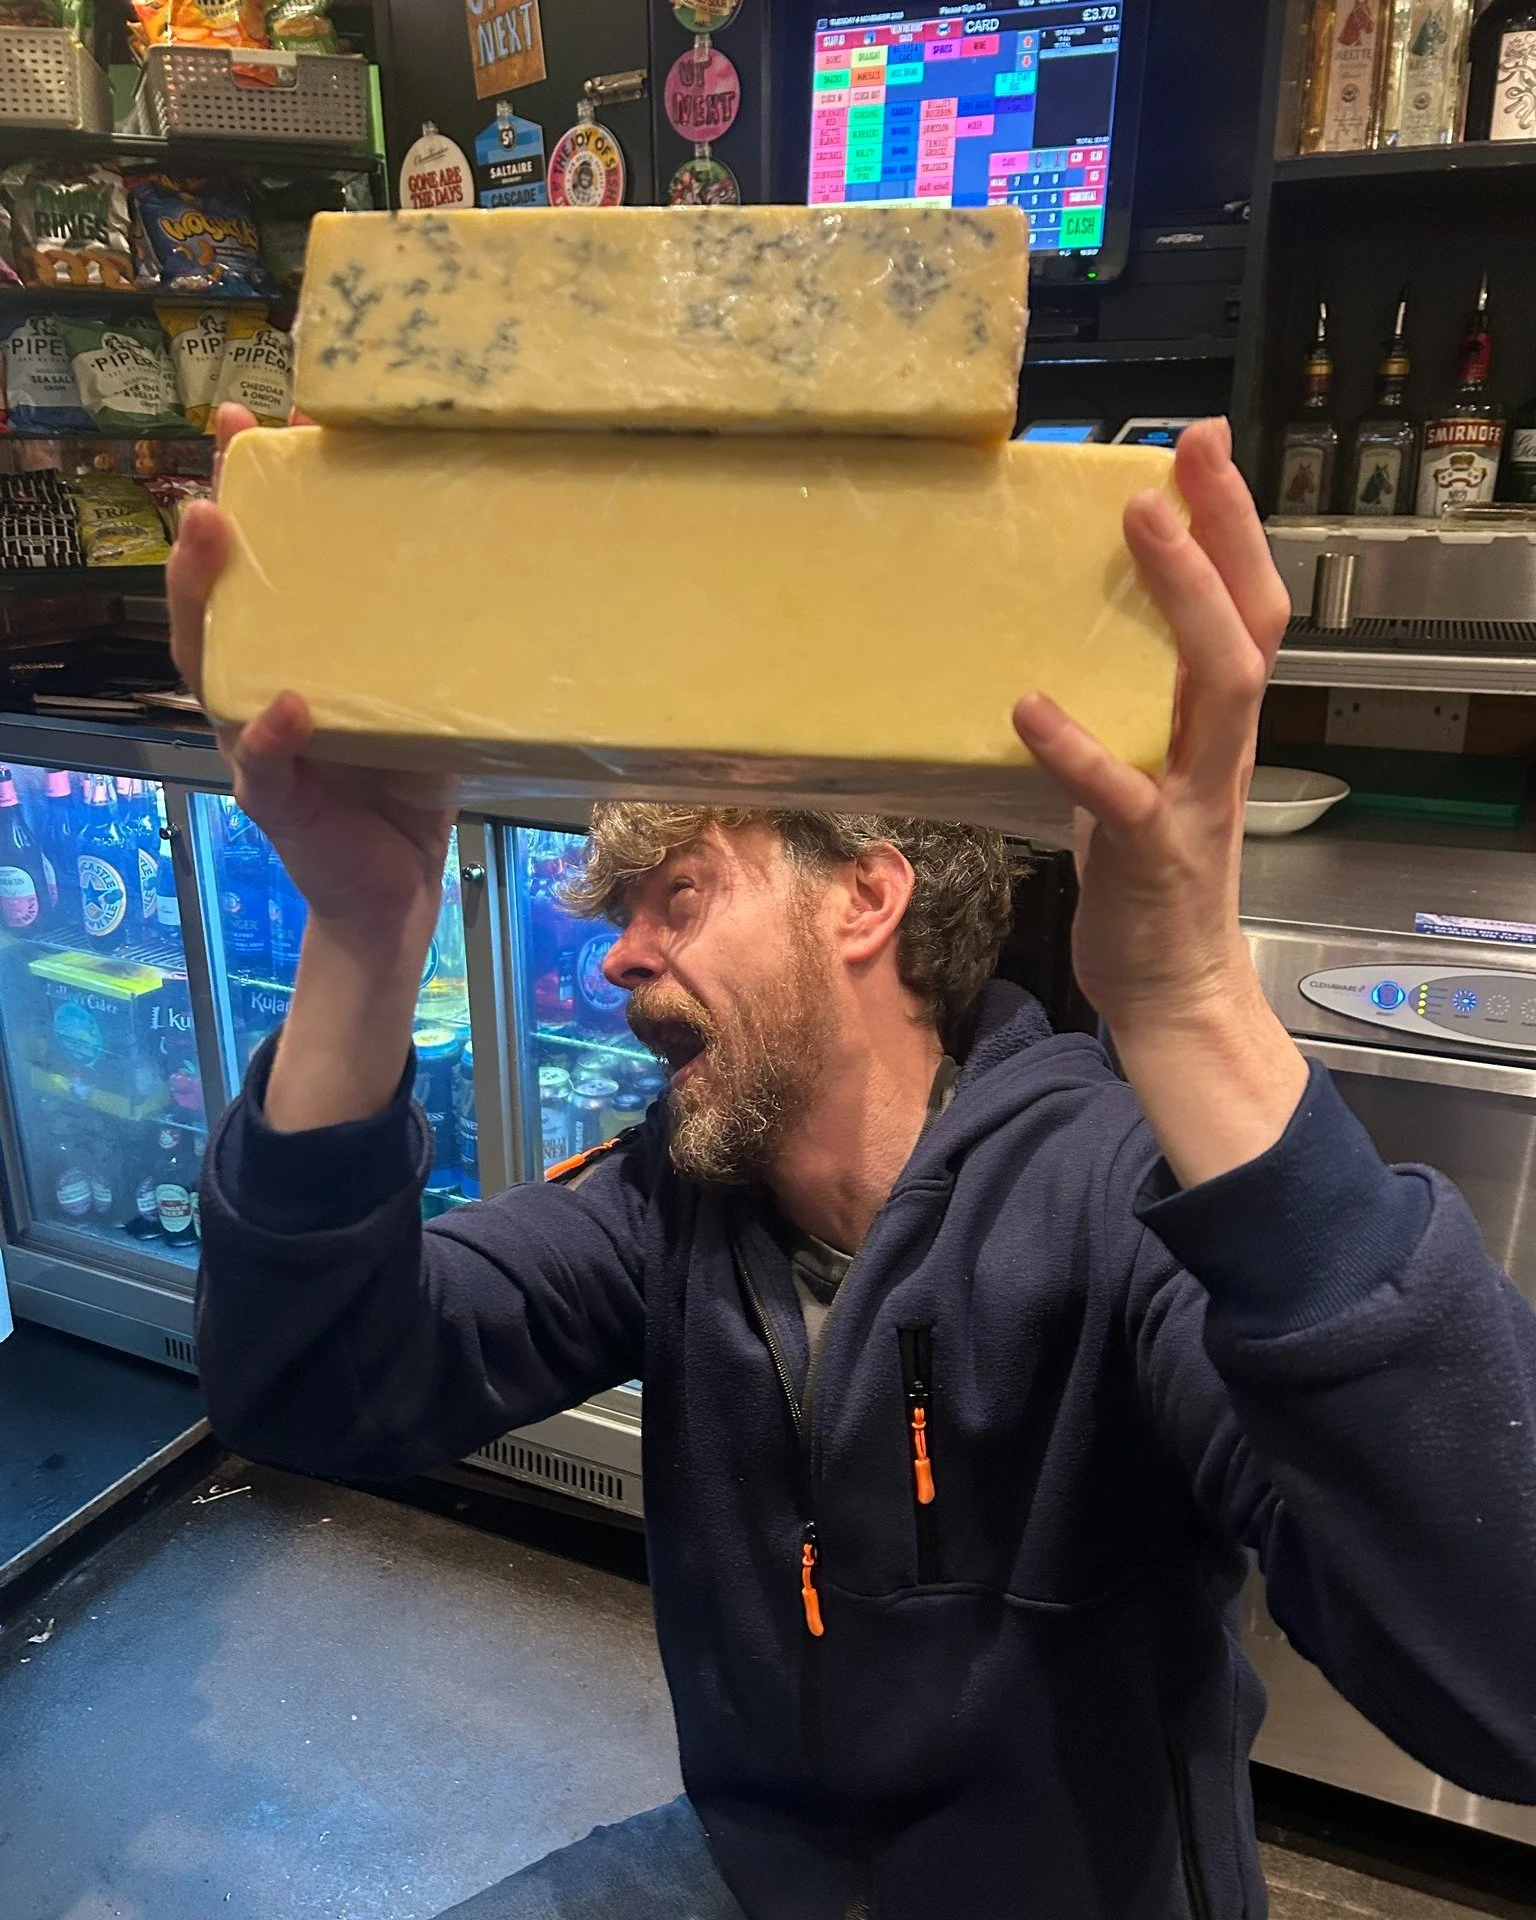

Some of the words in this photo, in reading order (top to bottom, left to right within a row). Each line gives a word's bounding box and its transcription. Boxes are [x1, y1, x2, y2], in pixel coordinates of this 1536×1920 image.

[1082, 6, 1117, 22] £3.70
[476, 1, 533, 67] NEXT
[965, 18, 1000, 33] CARD
[672, 91, 735, 126] NEXT
[570, 131, 592, 151] JOY
[595, 136, 611, 156] OF
[408, 171, 438, 192] GONE
[439, 165, 462, 186] ARE
[489, 161, 533, 179] SALTAIRE
[410, 190, 434, 208] THE
[434, 185, 464, 206] DAYS
[491, 187, 537, 207] CASCADE
[35, 209, 110, 245] RINGS
[1066, 217, 1095, 236] CASH
[31, 375, 50, 383] SEA
[240, 381, 284, 397] CHEDDAR
[250, 391, 281, 405] ONION
[1427, 424, 1502, 445] SMIRNOFF
[87, 994, 118, 1014] Cider
